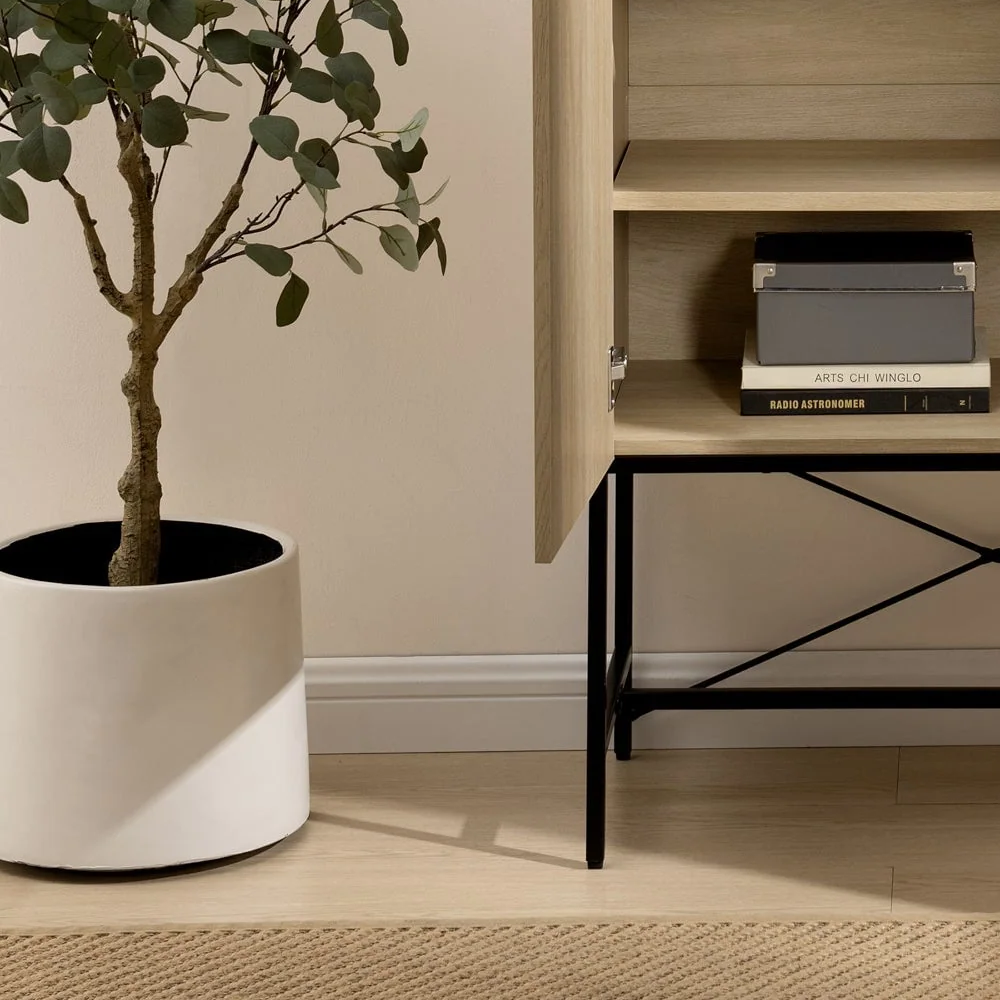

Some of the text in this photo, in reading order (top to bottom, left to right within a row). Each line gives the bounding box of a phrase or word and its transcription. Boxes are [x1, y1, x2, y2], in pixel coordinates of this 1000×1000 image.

[814, 372, 922, 383] ARTS CHI WINGLO
[770, 399, 865, 410] RADIO ASTRONOMER
